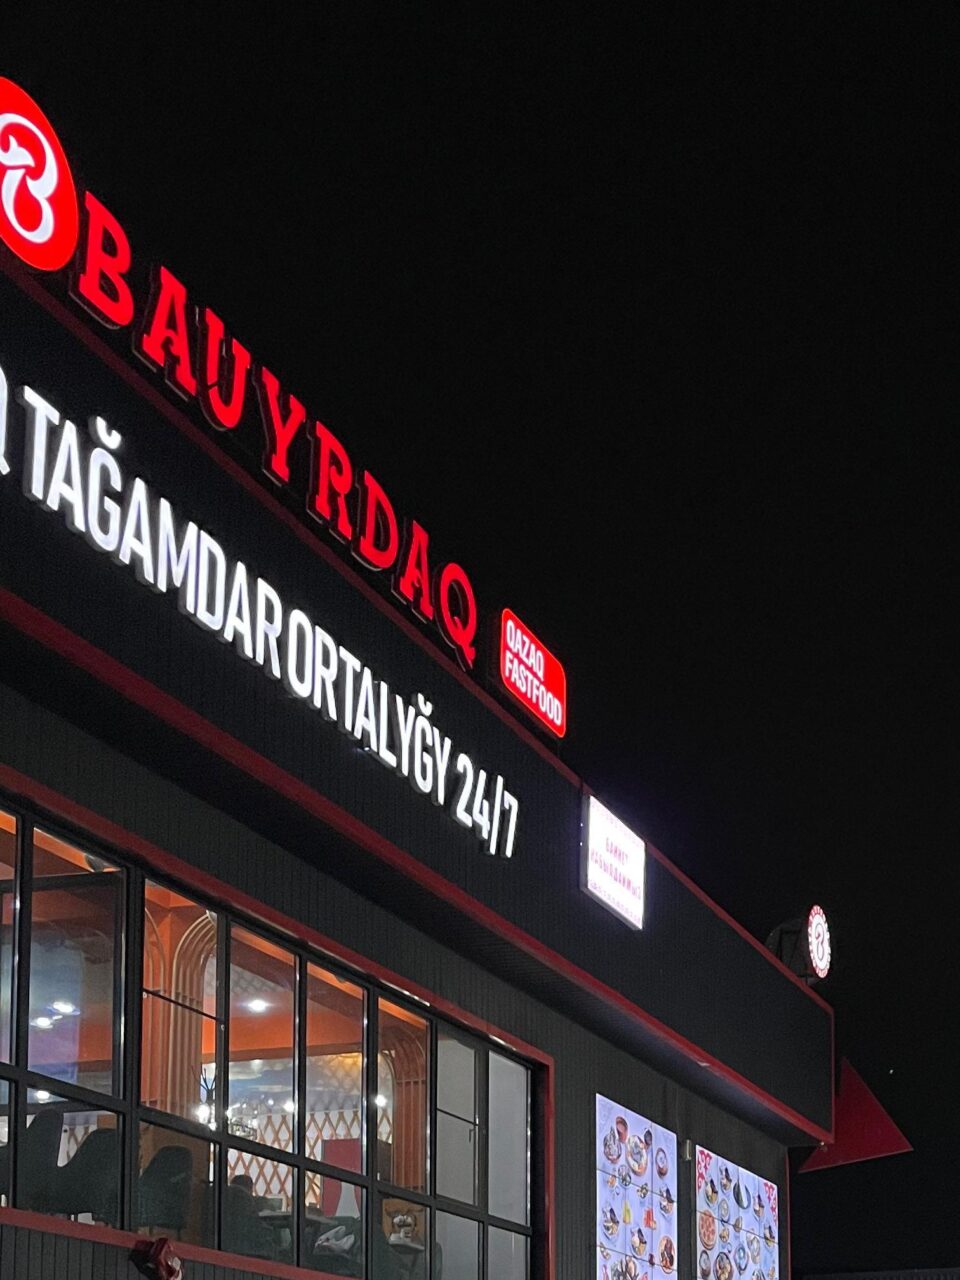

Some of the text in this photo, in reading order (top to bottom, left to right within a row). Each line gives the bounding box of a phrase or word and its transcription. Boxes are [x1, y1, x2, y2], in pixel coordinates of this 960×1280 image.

[78, 190, 477, 668] BAUYRDAQ
[23, 385, 283, 679] TAĞAMDAR
[286, 609, 452, 806] ORTALYĞY
[456, 753, 519, 858] 24/7
[505, 650, 562, 727] FASTFOOD
[506, 619, 545, 682] QAZAQ
